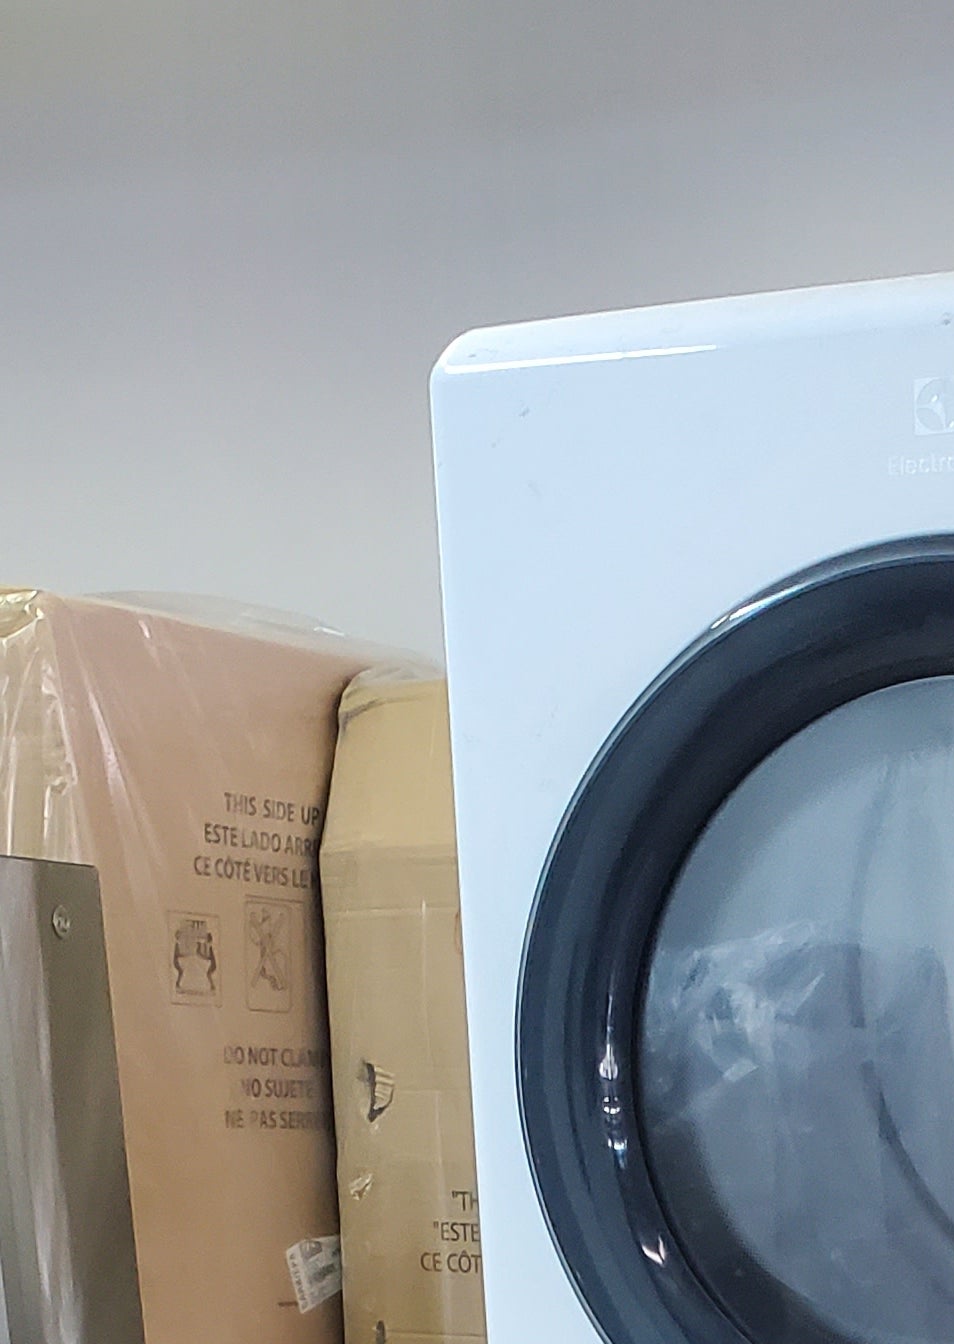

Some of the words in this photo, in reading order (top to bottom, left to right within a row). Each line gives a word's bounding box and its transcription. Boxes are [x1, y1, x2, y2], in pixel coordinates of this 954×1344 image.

[224, 792, 256, 816] THIS
[263, 799, 295, 822] SIDE
[301, 806, 320, 827] UP
[204, 823, 238, 847] ESTE
[241, 830, 281, 852] LADO
[194, 856, 211, 876] CE
[253, 862, 289, 886] VERS
[224, 1046, 245, 1064] DO
[248, 1047, 278, 1066] NOT
[421, 1252, 442, 1272] CE
